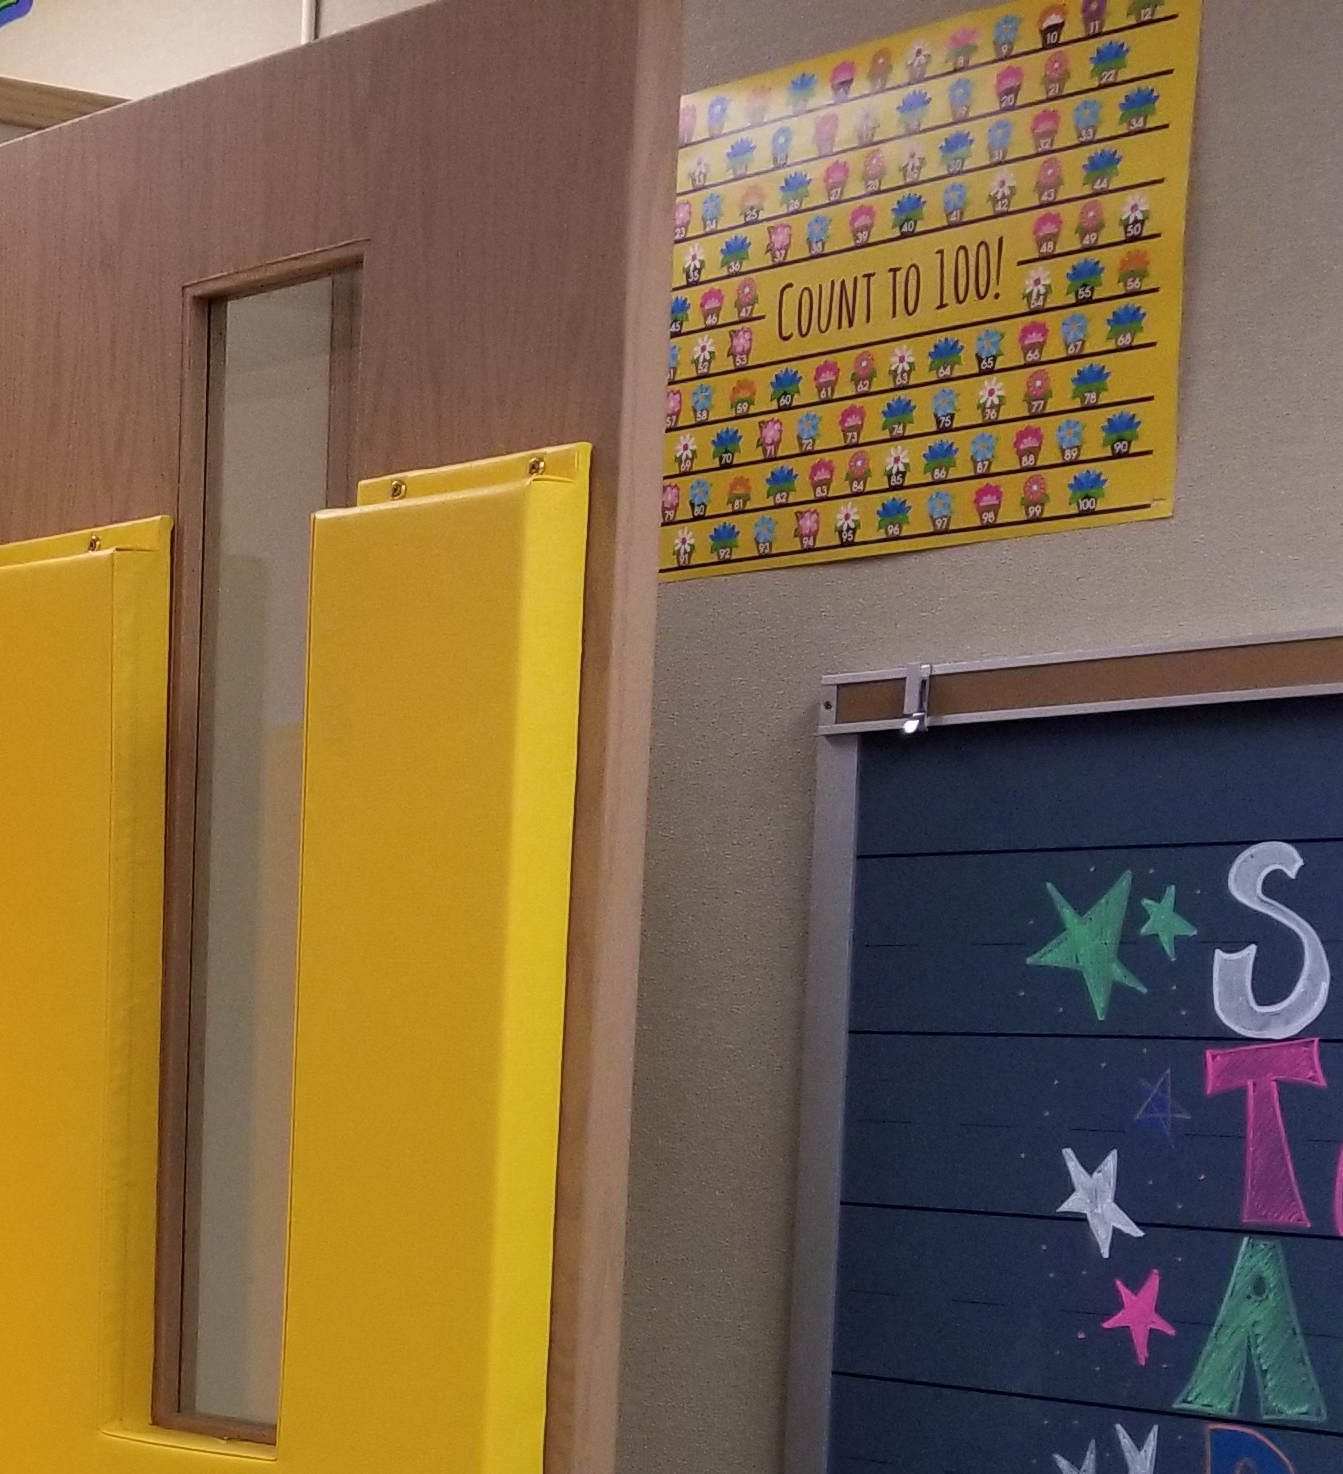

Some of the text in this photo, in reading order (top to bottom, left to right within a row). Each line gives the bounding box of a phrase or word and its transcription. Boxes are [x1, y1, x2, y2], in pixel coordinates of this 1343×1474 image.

[1046, 32, 1058, 44] 10
[1089, 21, 1100, 33] 11
[1140, 8, 1152, 20] 12
[1001, 94, 1014, 106] 20
[1049, 84, 1059, 95] 21
[1101, 71, 1115, 82] 22
[674, 228, 686, 238] 23
[746, 211, 758, 221] 25
[830, 188, 841, 200] 27
[994, 148, 1003, 160] 31
[1079, 130, 1093, 141] 33
[1130, 117, 1144, 129] 34
[688, 271, 699, 282] 35
[728, 261, 740, 272] 36
[774, 250, 786, 261] 37
[856, 231, 868, 243] 39
[901, 220, 914, 231] 40
[950, 210, 960, 220] 41
[995, 200, 1008, 210] 42
[1042, 189, 1055, 200] 43
[1093, 178, 1107, 189] 44
[1040, 224, 1141, 252] 48 49 50
[671, 306, 753, 331] 45 46 47
[777, 236, 1004, 341] COUNT TO 100!
[1078, 287, 1092, 298] 55
[1127, 278, 1141, 289] 56
[666, 415, 676, 427] 57
[696, 410, 707, 421] 58
[736, 402, 748, 413] 59
[779, 395, 791, 406] 60
[820, 387, 832, 398] 61
[857, 380, 870, 391] 62
[896, 373, 908, 384] 63
[939, 366, 951, 376] 64
[981, 357, 994, 369] 65
[1026, 350, 1040, 360] 66
[1068, 341, 1082, 353] 67
[698, 362, 709, 373] 52
[735, 354, 747, 365] 53
[680, 392, 1097, 472] 69 70 71 72 73 74 75 76 77 78
[664, 509, 675, 521] 79
[734, 498, 744, 509] 81
[815, 485, 828, 497] 83
[852, 480, 864, 491] 84
[891, 474, 903, 485] 85
[933, 468, 946, 479] 86
[976, 461, 989, 472] 87
[1021, 454, 1035, 466] 88
[1064, 448, 1078, 459] 89
[1114, 441, 1127, 453] 90
[679, 498, 1096, 566] 91 92 93 94 95 96 97 98 99 100
